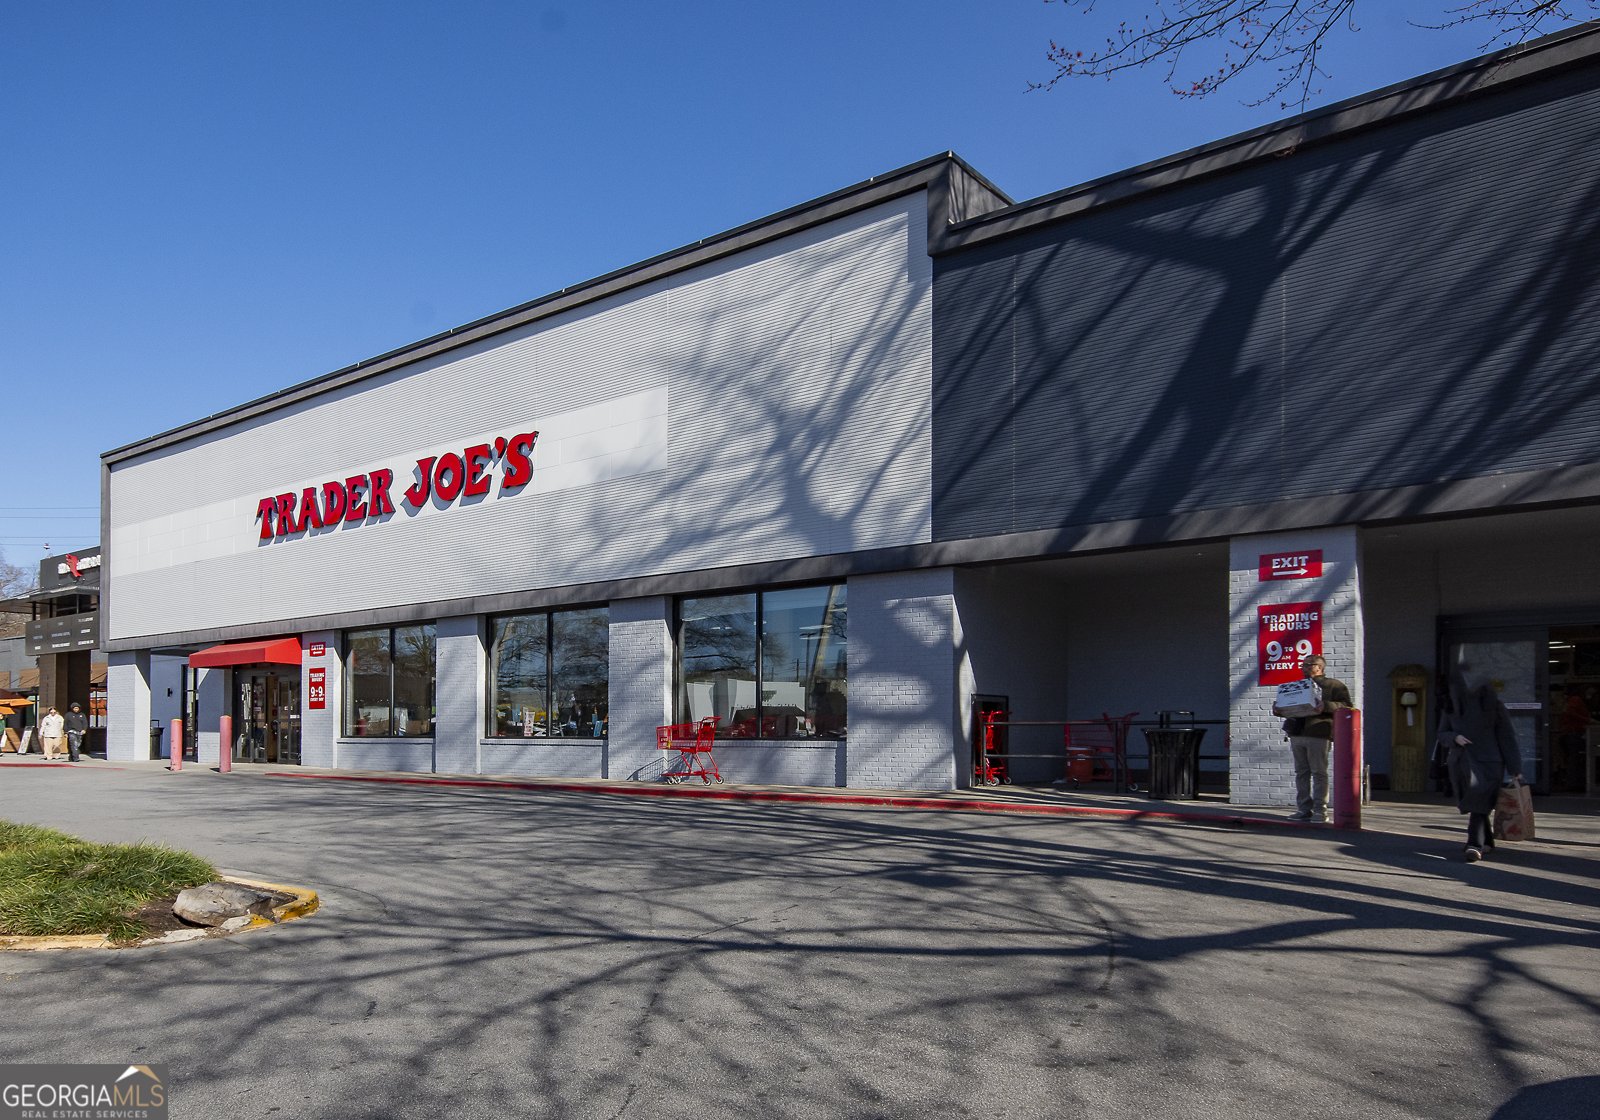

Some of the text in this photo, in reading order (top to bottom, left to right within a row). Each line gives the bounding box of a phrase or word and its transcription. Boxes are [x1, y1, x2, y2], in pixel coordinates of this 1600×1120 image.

[256, 431, 539, 540] TRADER JOE'S
[1272, 556, 1309, 569] EXIT
[1262, 612, 1318, 624] TRADING
[1270, 621, 1310, 632] HOURS
[1266, 640, 1283, 662] 9
[1296, 639, 1313, 661] 9
[1265, 662, 1295, 670] EVERY
[310, 685, 323, 697] 9 9
